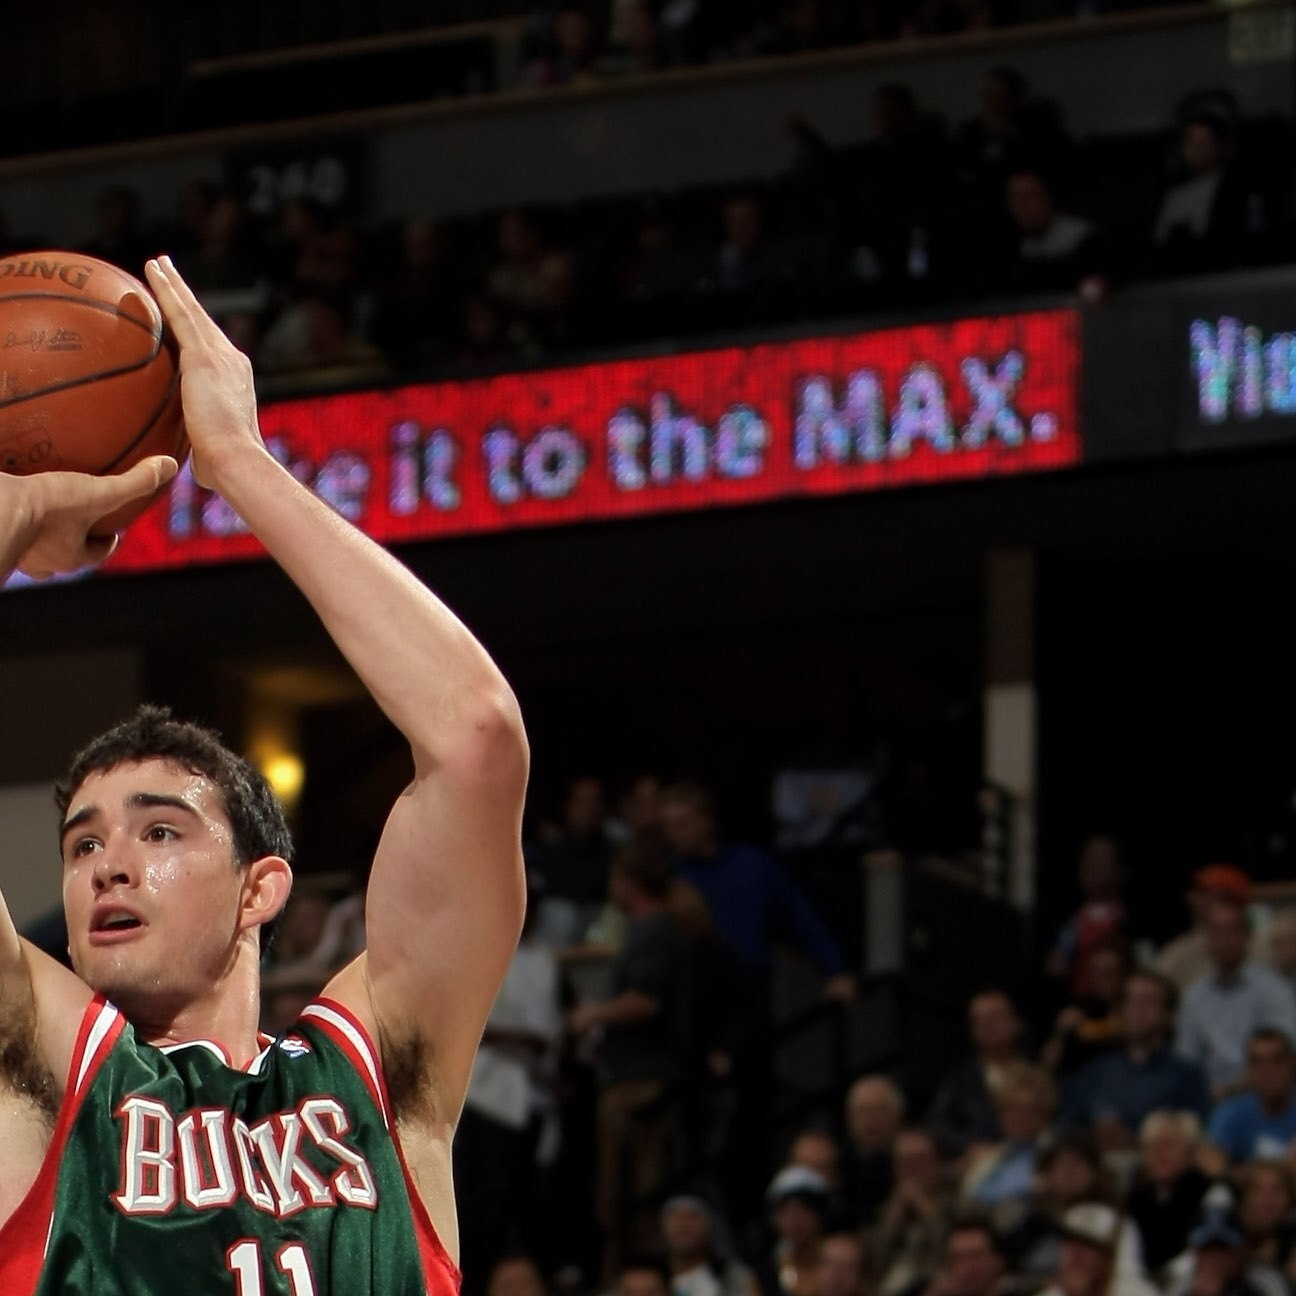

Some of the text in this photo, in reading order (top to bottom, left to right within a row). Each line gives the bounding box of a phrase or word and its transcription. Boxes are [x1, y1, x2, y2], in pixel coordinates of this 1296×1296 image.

[390, 420, 461, 515] it
[482, 424, 588, 504] to
[607, 390, 770, 491] the
[794, 349, 1058, 471] MAX.
[111, 1095, 378, 1219] BUCKS
